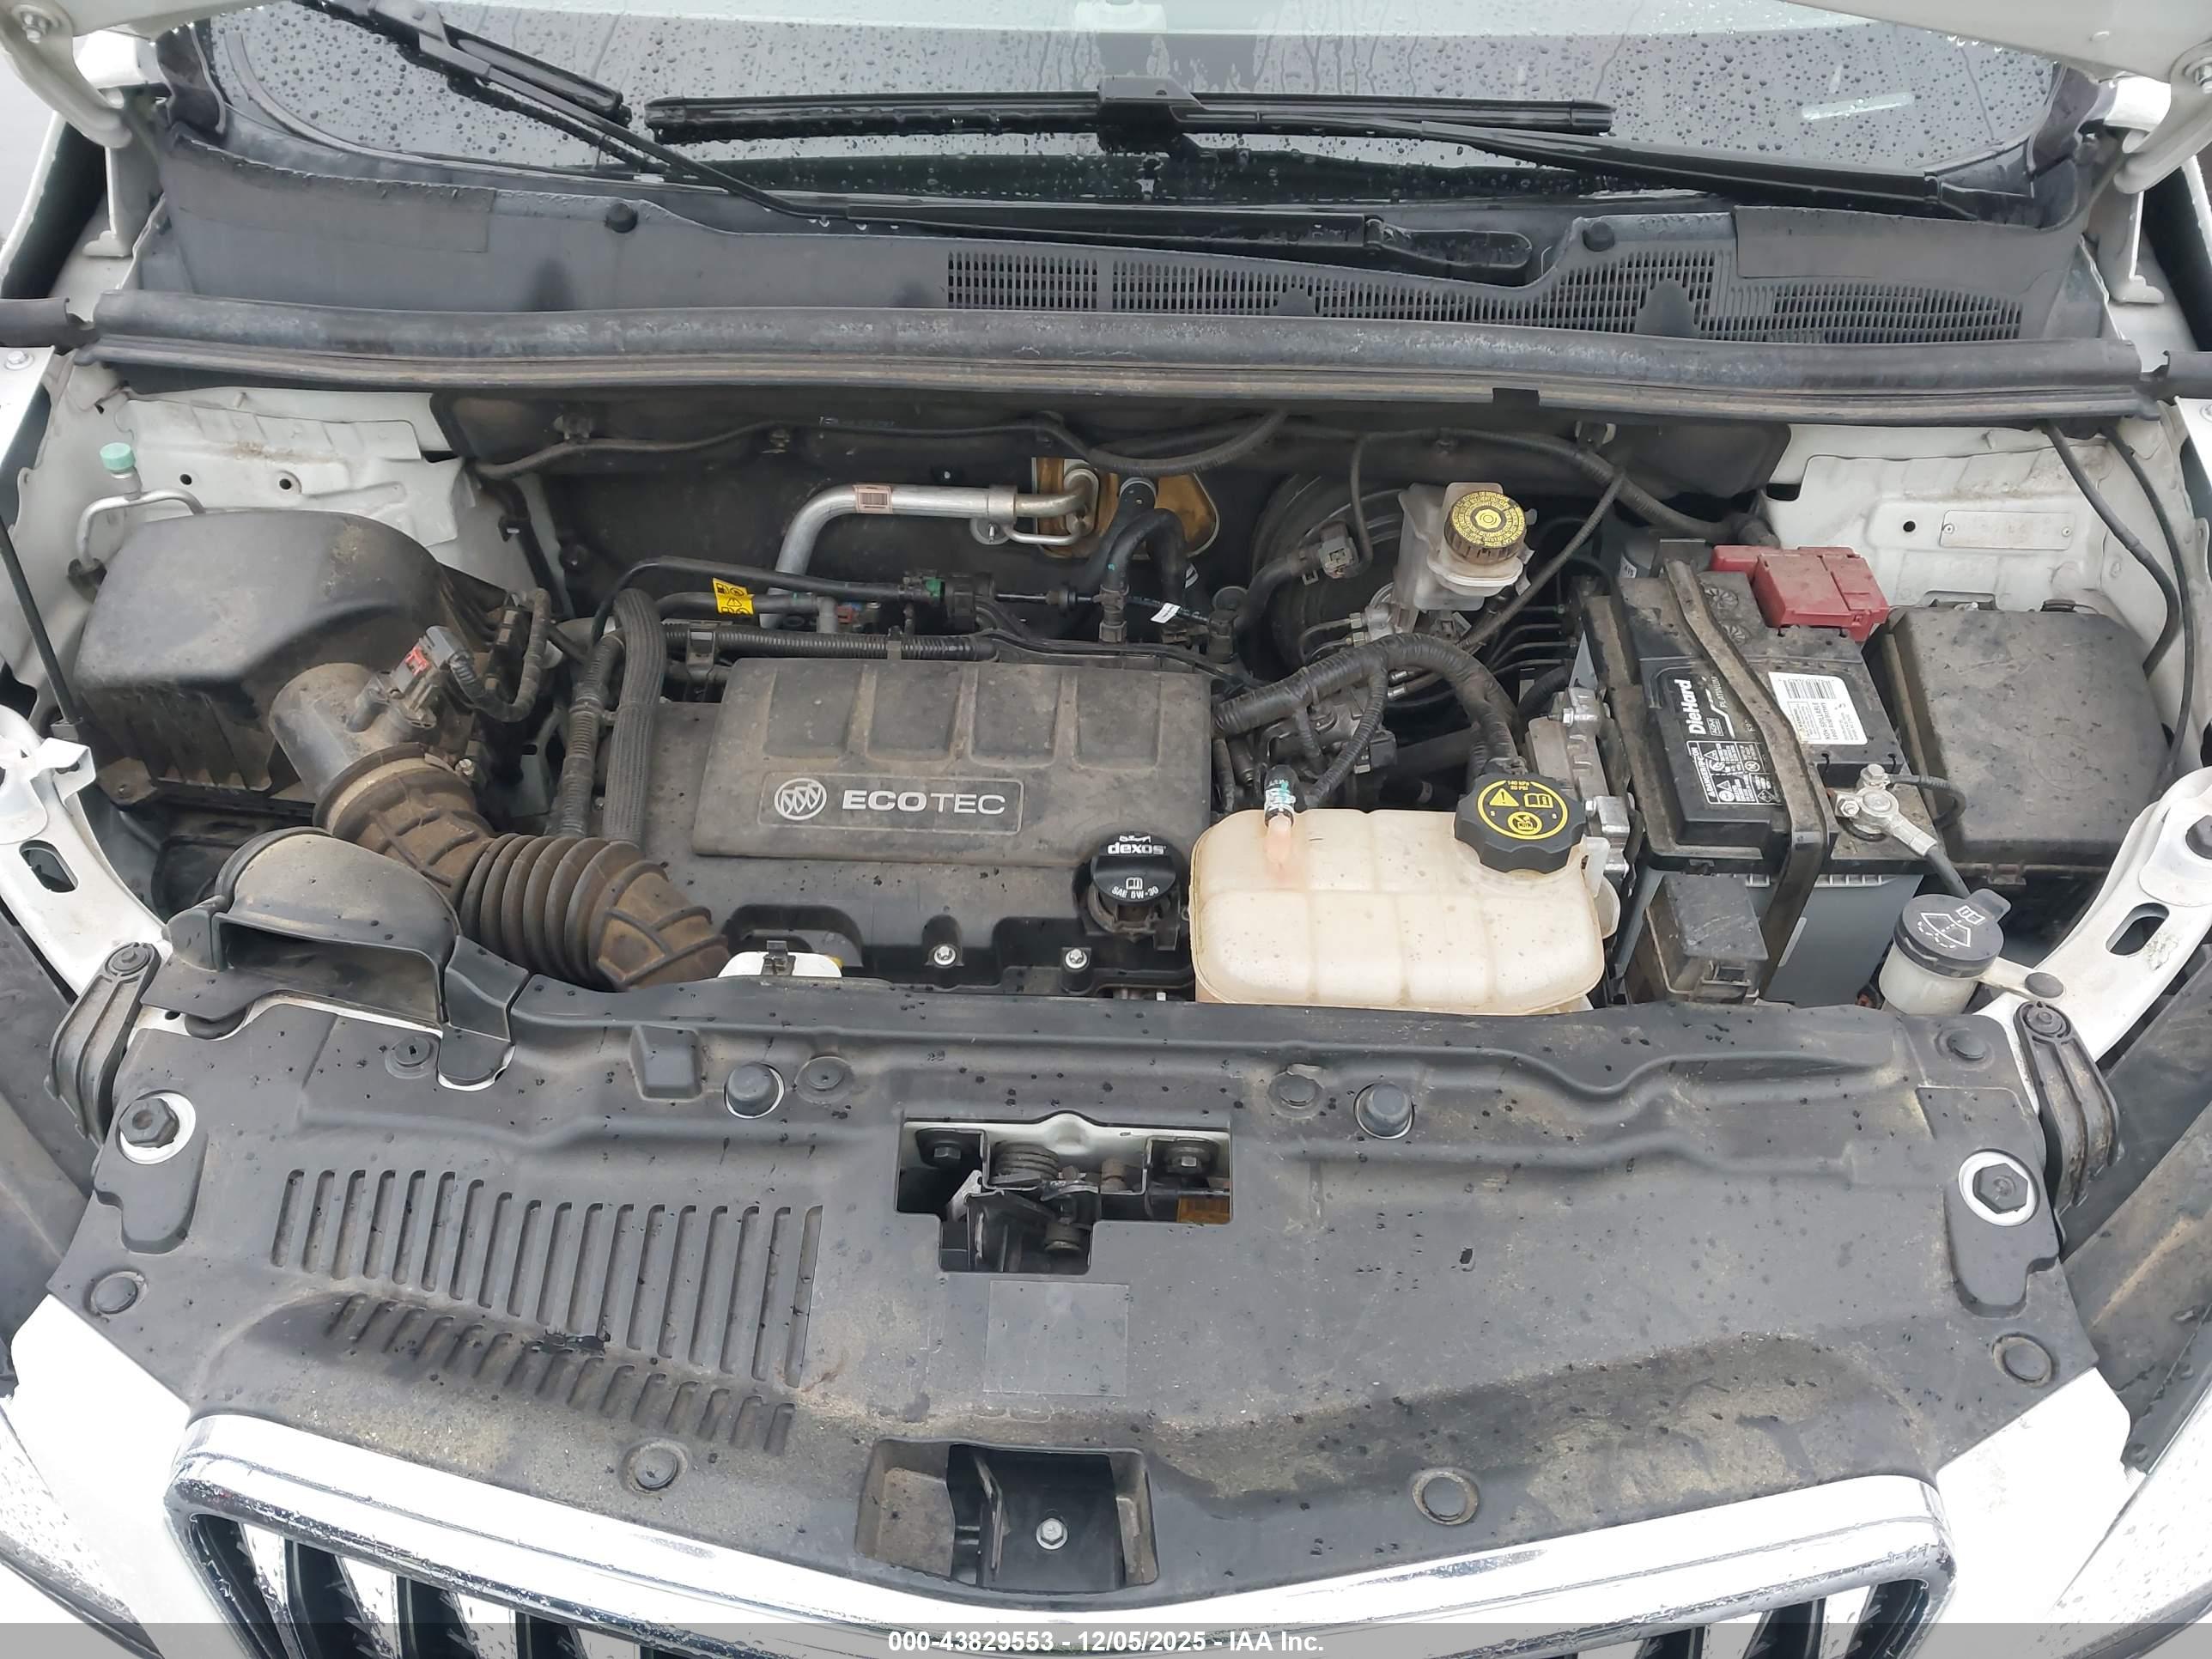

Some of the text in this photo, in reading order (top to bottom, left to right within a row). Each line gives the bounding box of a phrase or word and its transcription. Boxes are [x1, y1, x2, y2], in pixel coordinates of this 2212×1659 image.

[1711, 676, 1728, 708] PLATINUM
[1674, 678, 1707, 735] DieHard
[842, 790, 1006, 815] ECOTEC
[1108, 842, 1164, 855] dexos
[1111, 885, 1128, 898] SAE
